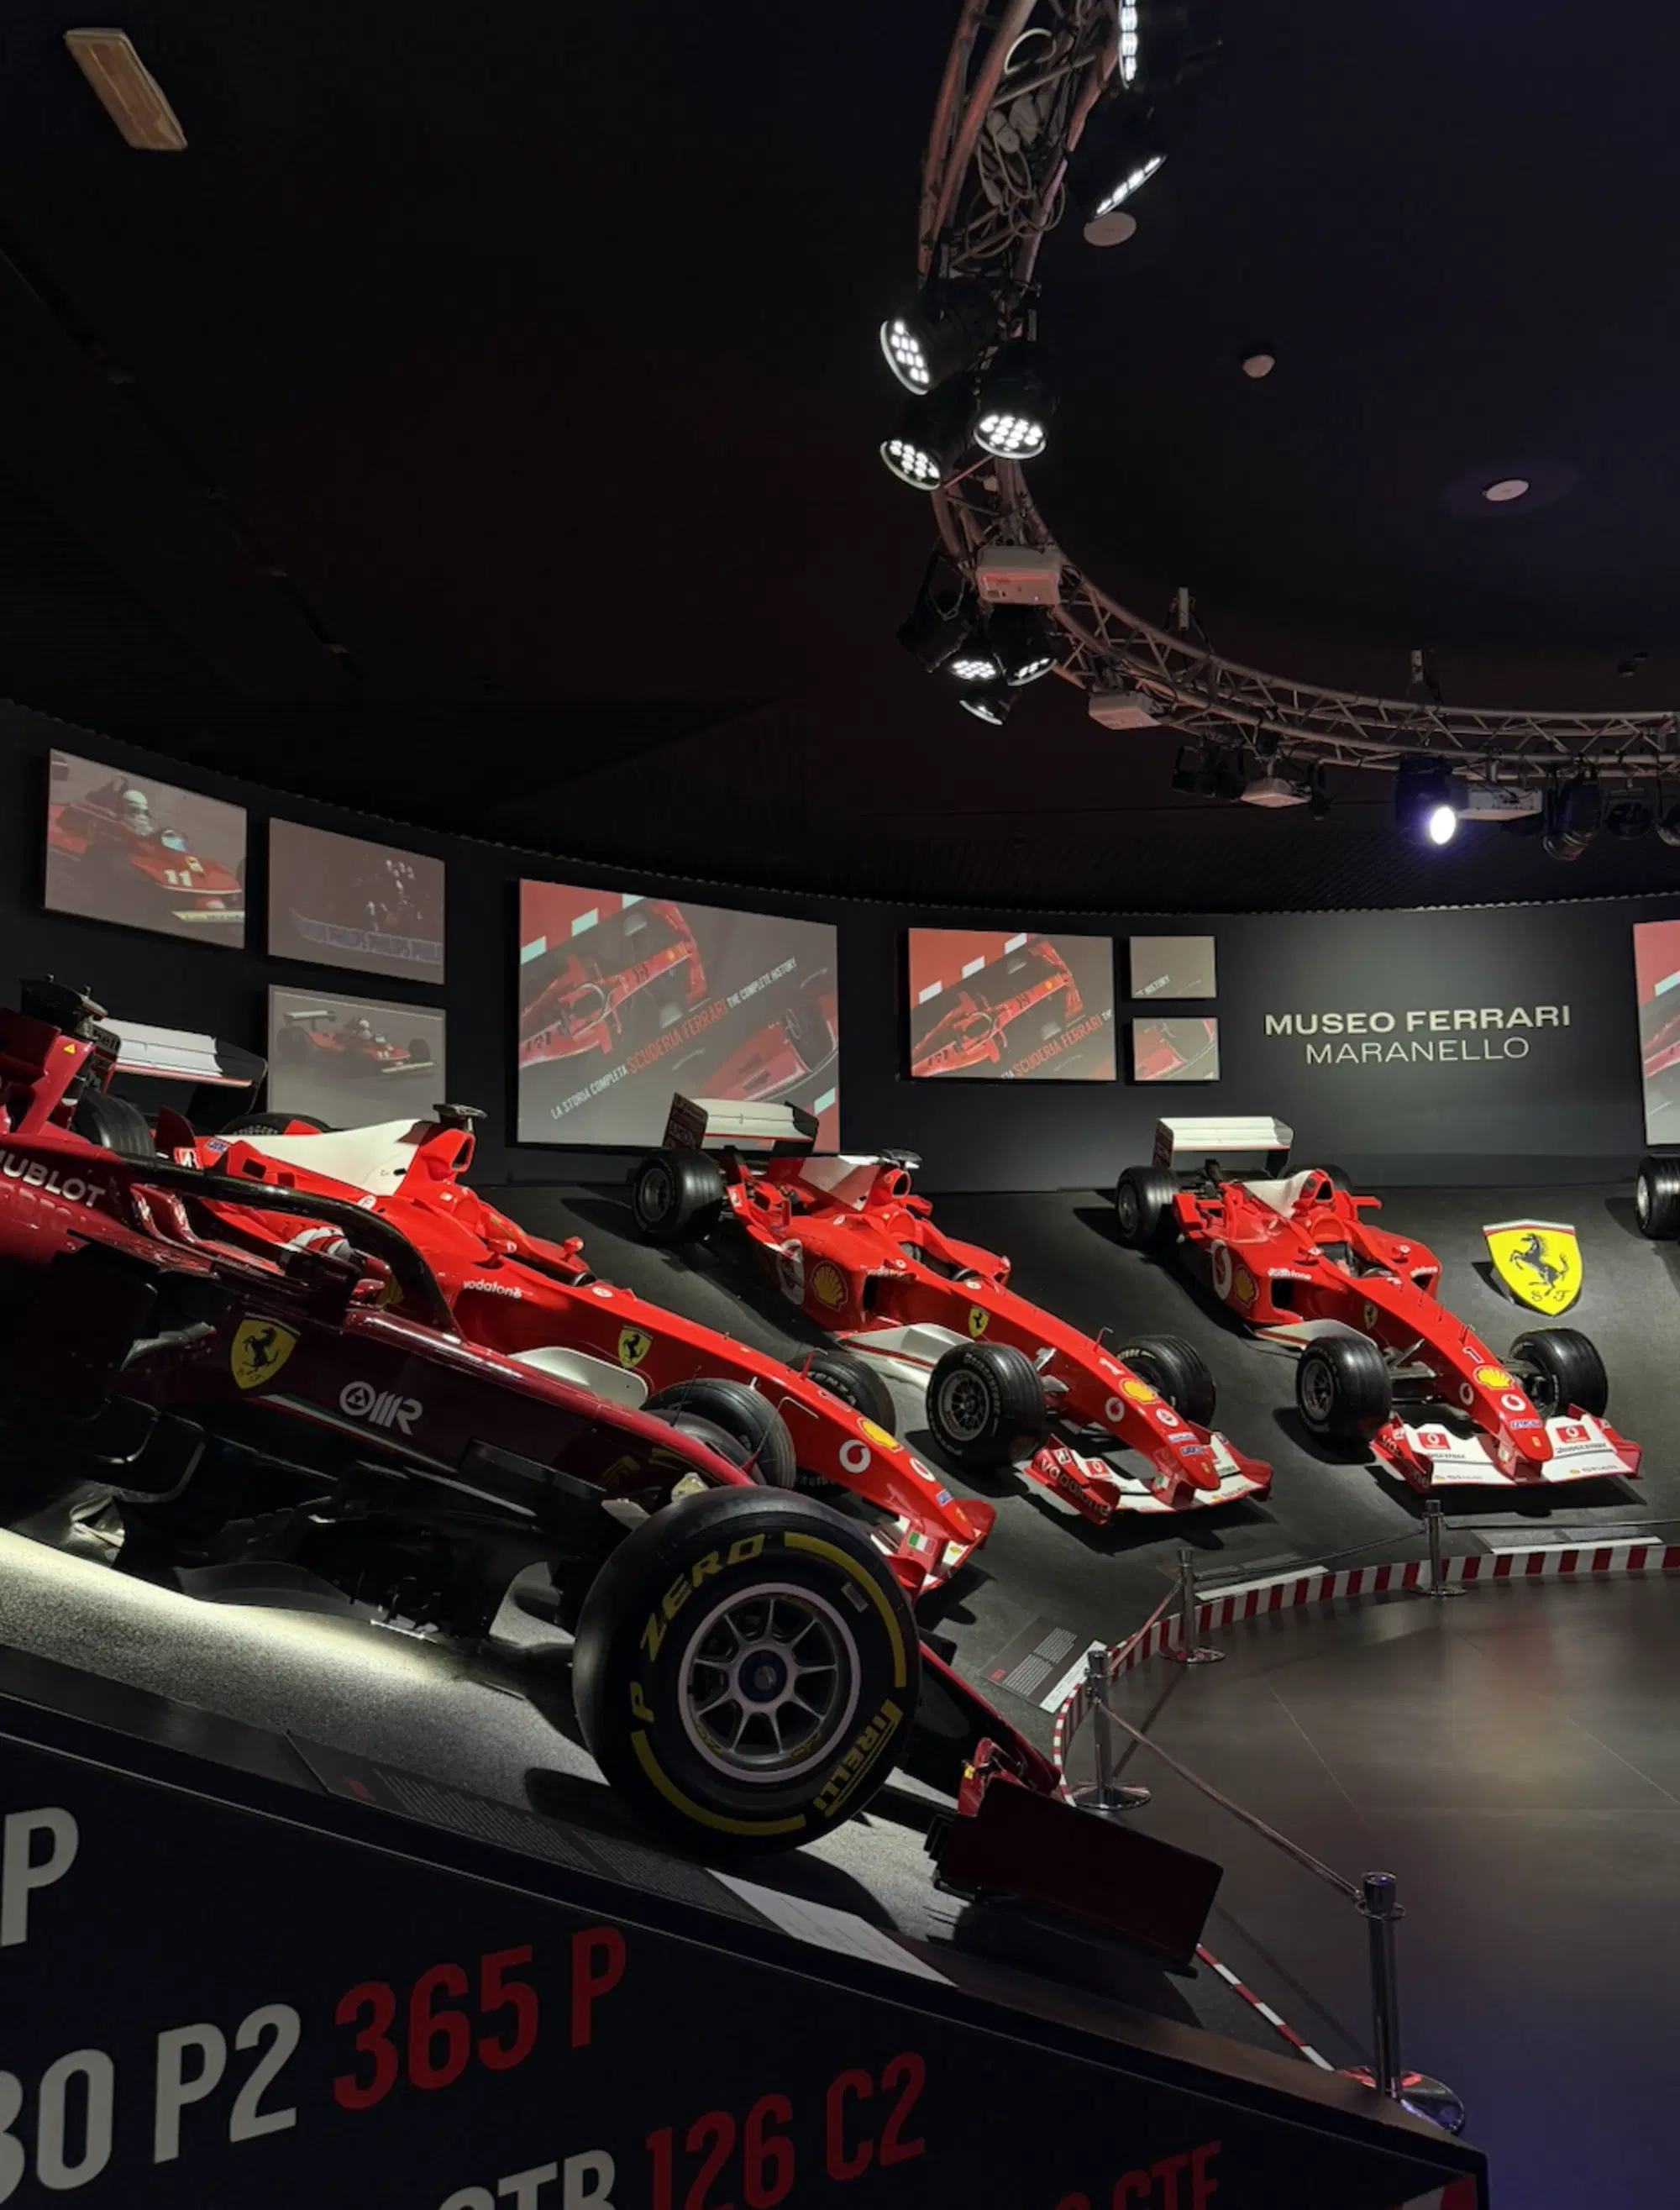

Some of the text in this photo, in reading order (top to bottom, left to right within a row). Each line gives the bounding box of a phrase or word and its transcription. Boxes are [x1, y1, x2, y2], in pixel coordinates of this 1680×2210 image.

[550, 1103, 564, 1120] LA
[562, 1090, 591, 1115] STORIA
[590, 1063, 628, 1098] COMPLETA
[625, 1028, 684, 1074] SCUDERIA
[681, 1000, 729, 1039] FERRARI
[1012, 1040, 1063, 1077] SCUDERIA
[1060, 1016, 1103, 1048] FERRARI
[1264, 1005, 1571, 1036] MUSEO FERRARI
[1305, 1037, 1530, 1065] MARANELLO
[463, 1278, 522, 1299] vodafone
[640, 1534, 766, 1662] ZERO
[630, 1681, 655, 1722] P
[813, 1698, 904, 1819] PIRELLI
[2, 1807, 79, 1947] P
[154, 2003, 302, 2164] P2
[333, 1945, 539, 2111] 365
[570, 1925, 626, 2048] P
[645, 2093, 795, 2210] 126
[825, 2052, 926, 2181] C2
